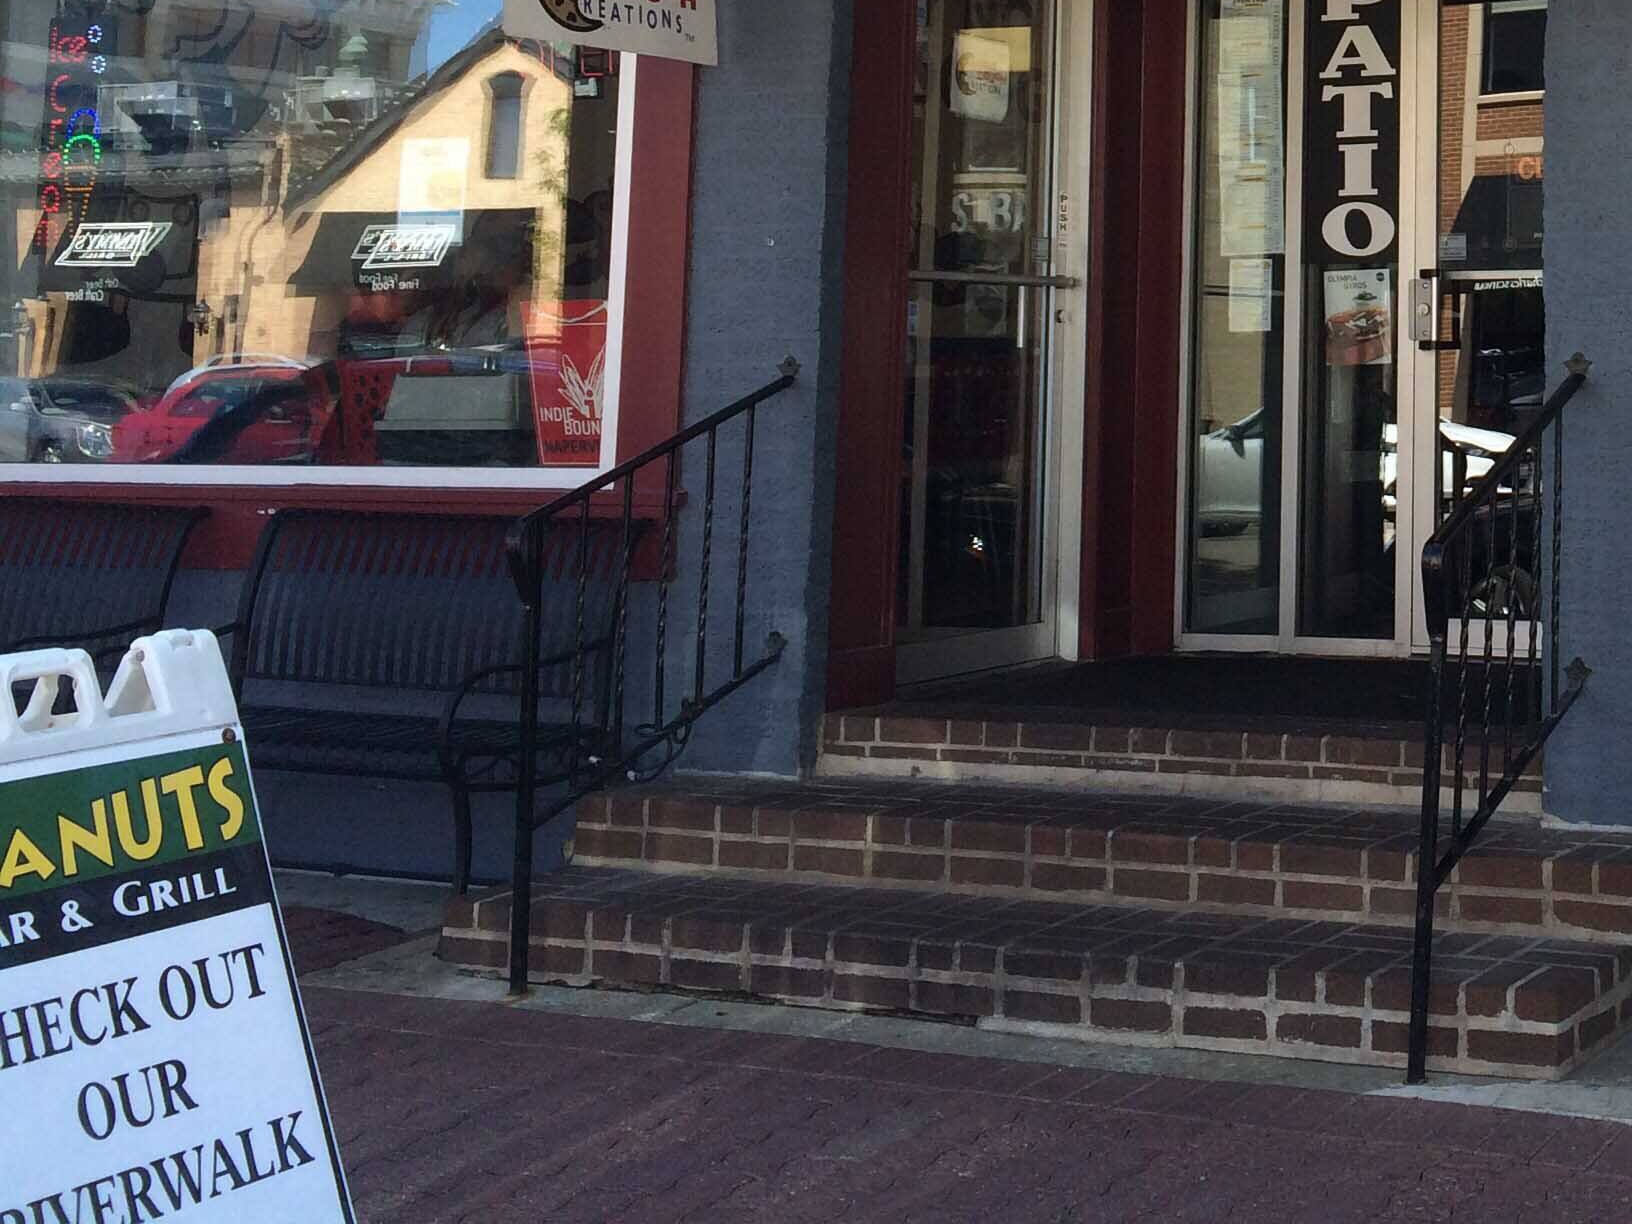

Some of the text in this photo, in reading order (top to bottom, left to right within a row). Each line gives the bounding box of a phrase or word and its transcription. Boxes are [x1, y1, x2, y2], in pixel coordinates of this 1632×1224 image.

[60, 900, 94, 933] &
[112, 868, 237, 917] GRILL
[158, 942, 266, 1021] OUT
[77, 1059, 200, 1141] OUR
[0, 1110, 316, 1224] VERWALK
